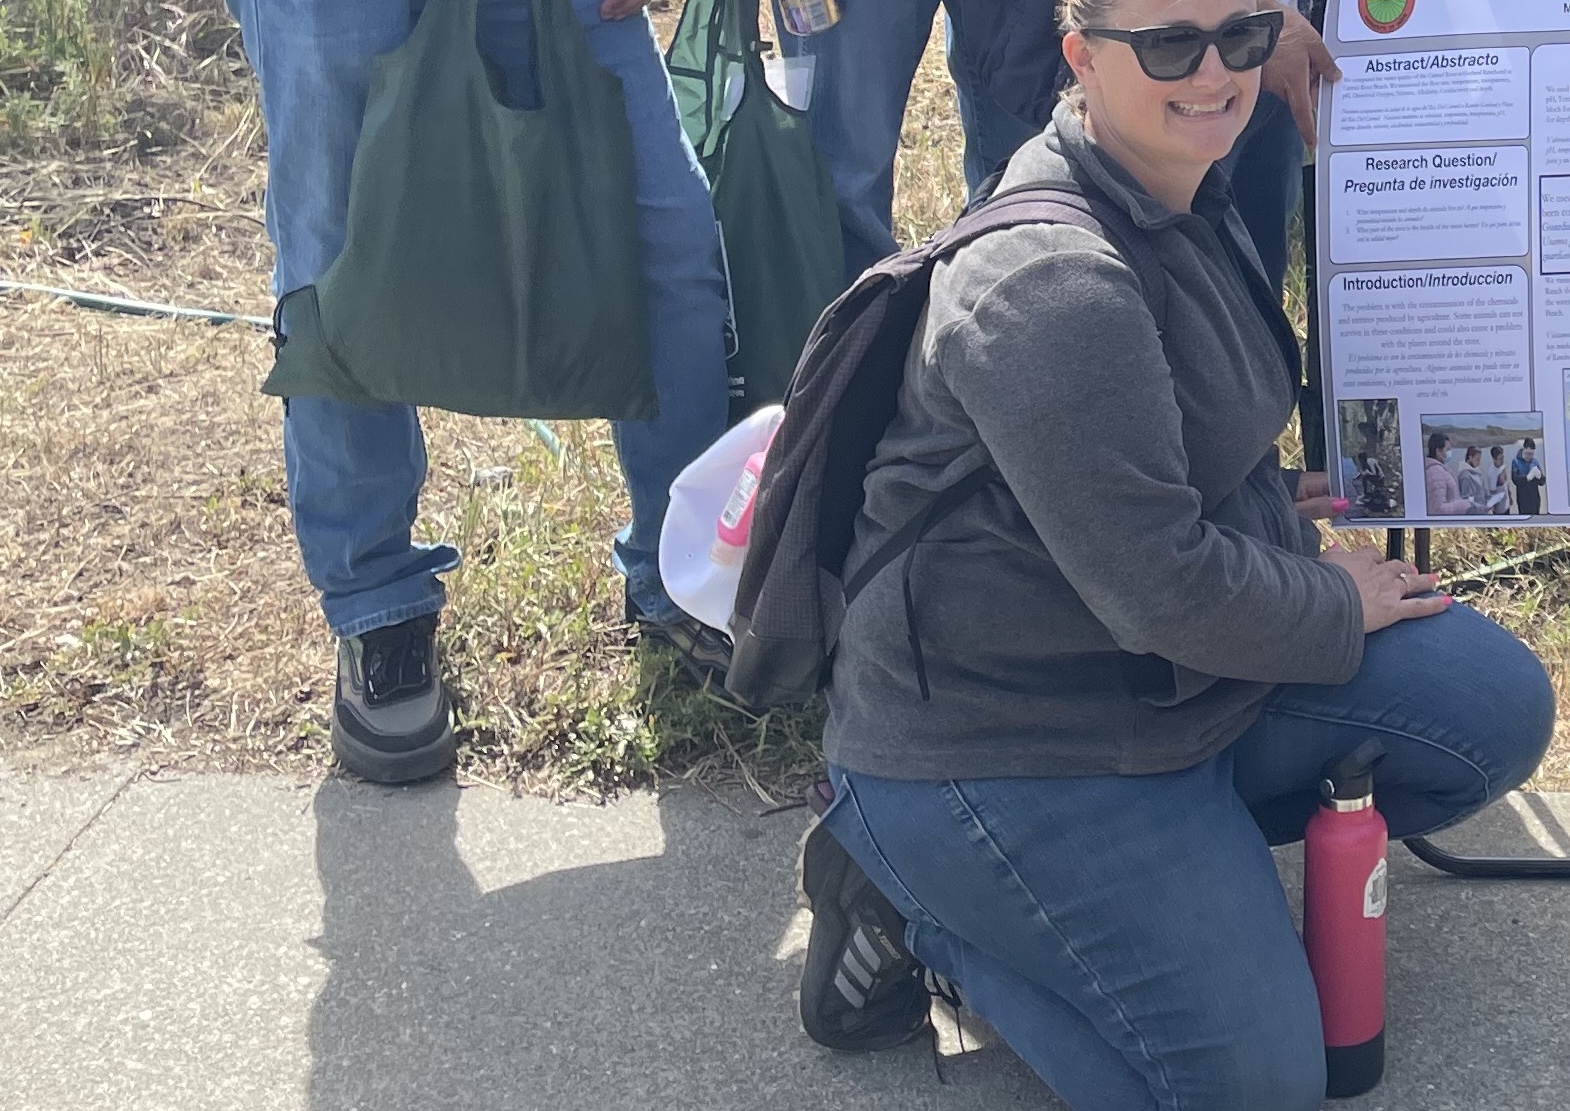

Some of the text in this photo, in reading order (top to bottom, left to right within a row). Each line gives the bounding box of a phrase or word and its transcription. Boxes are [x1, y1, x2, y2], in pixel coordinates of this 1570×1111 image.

[1365, 53, 1498, 72] Abstract/Abstracto
[1365, 152, 1497, 170] Research Question/
[1344, 173, 1517, 196] Pregunta de investigación
[1343, 272, 1512, 290] Introduction/Introduccion
